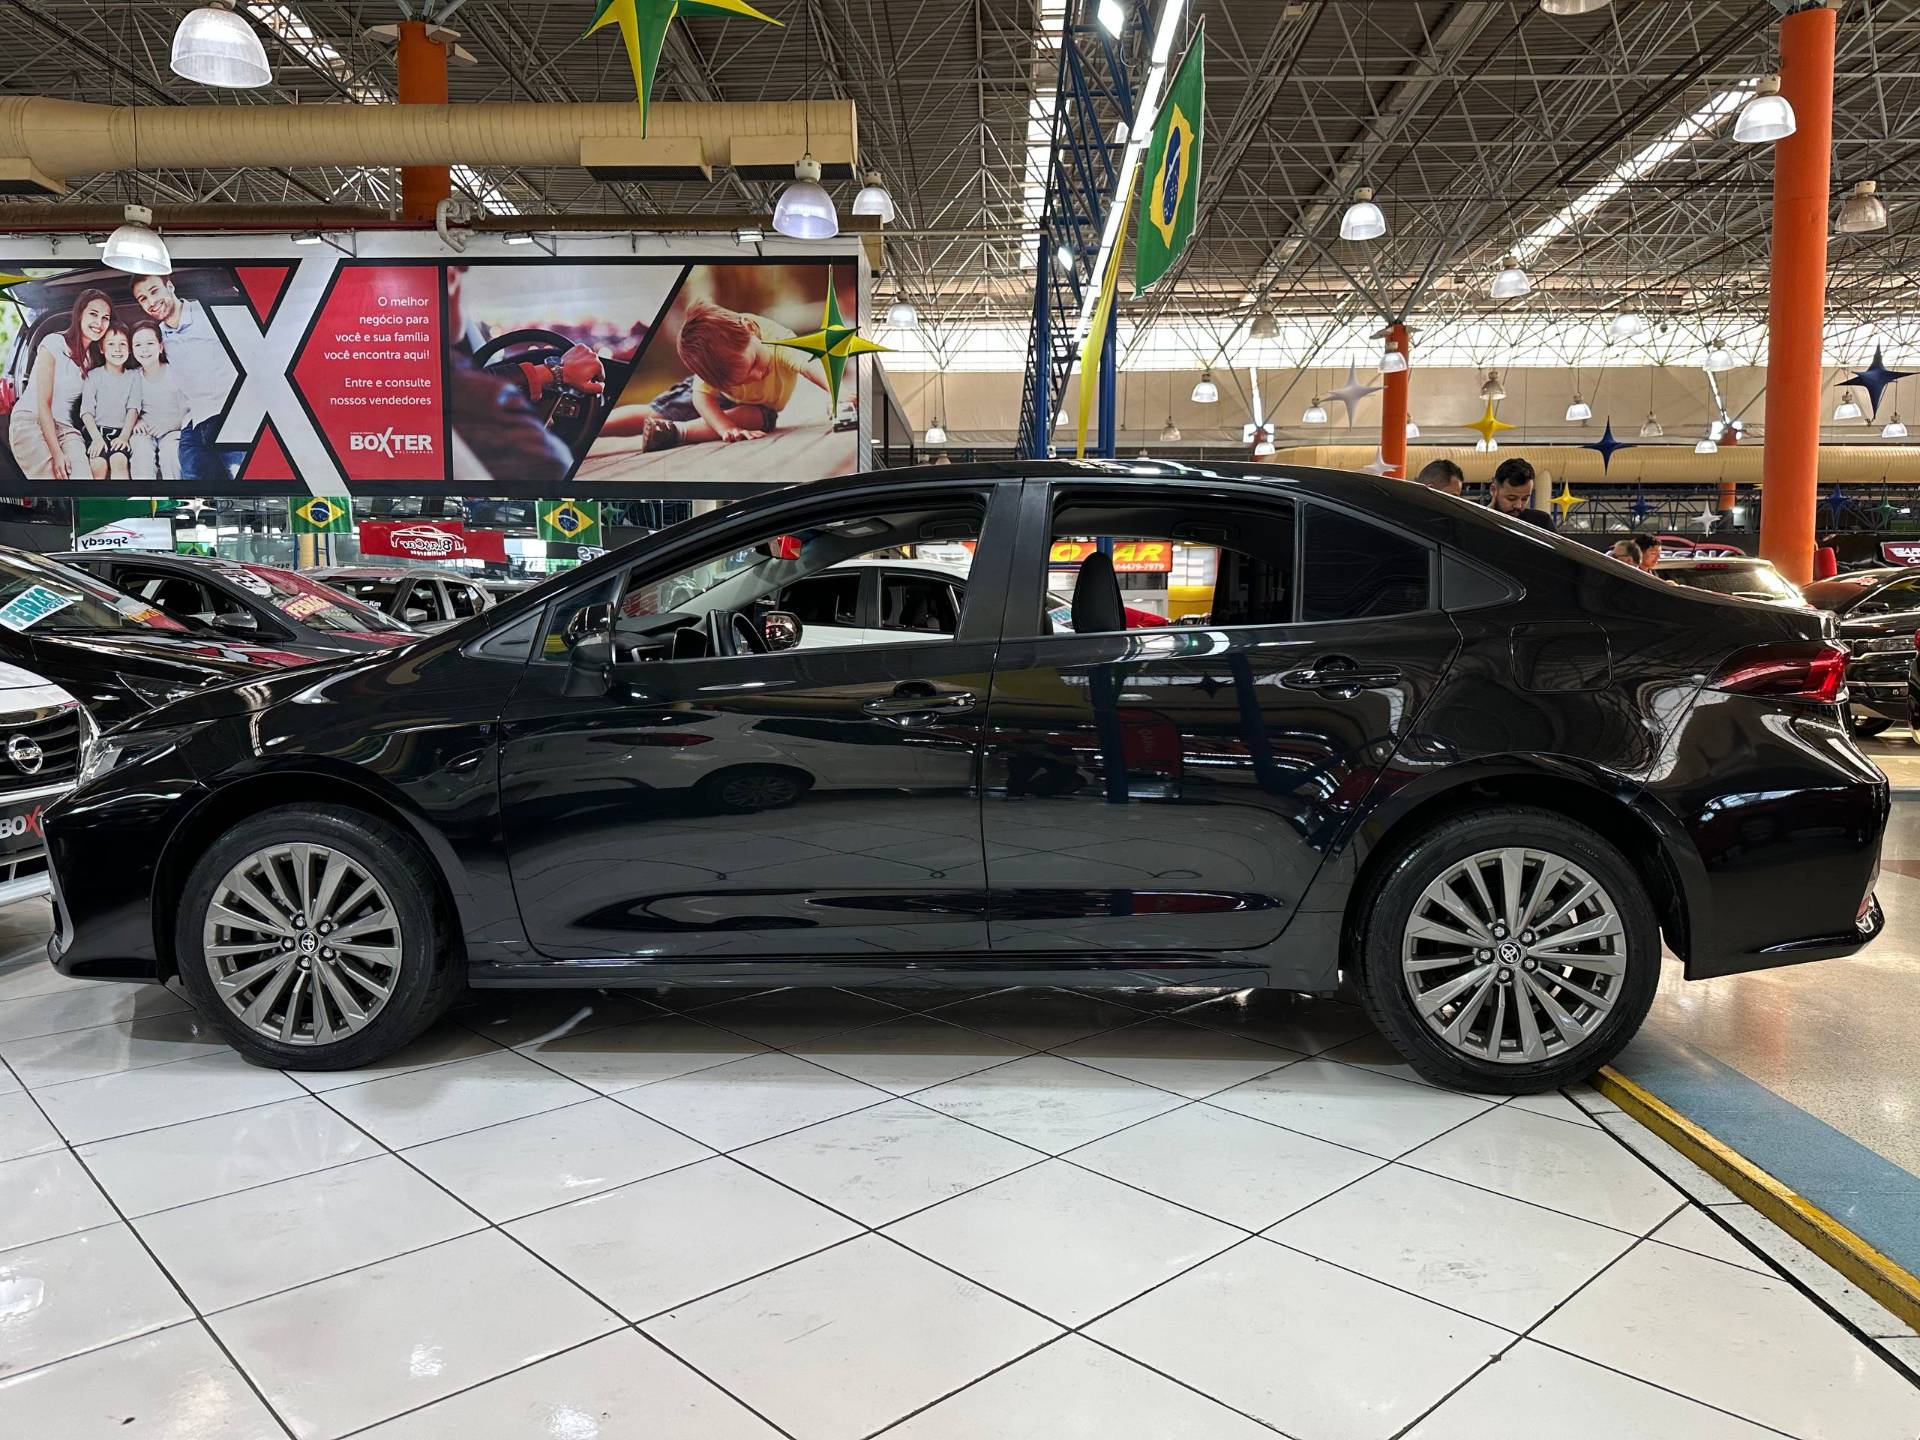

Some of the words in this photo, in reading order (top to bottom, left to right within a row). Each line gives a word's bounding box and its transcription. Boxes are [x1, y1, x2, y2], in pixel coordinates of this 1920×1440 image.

[377, 296, 388, 307] O
[390, 296, 429, 307] melhor
[359, 313, 403, 327] negócio
[405, 316, 429, 327] para
[335, 331, 361, 342] você
[363, 334, 370, 342] e
[373, 334, 391, 342] sua
[394, 331, 430, 342] família
[324, 349, 350, 360] você
[352, 350, 401, 360] encontra
[403, 350, 430, 362] aqui!
[345, 377, 373, 388] Entre
[375, 379, 383, 388] e
[384, 378, 432, 388] consulte
[330, 396, 367, 405] nossos
[369, 395, 432, 405] vendedores
[350, 427, 433, 458] BOXTER
[1112, 544, 1165, 562] AR
[0, 804, 44, 839] BOX
